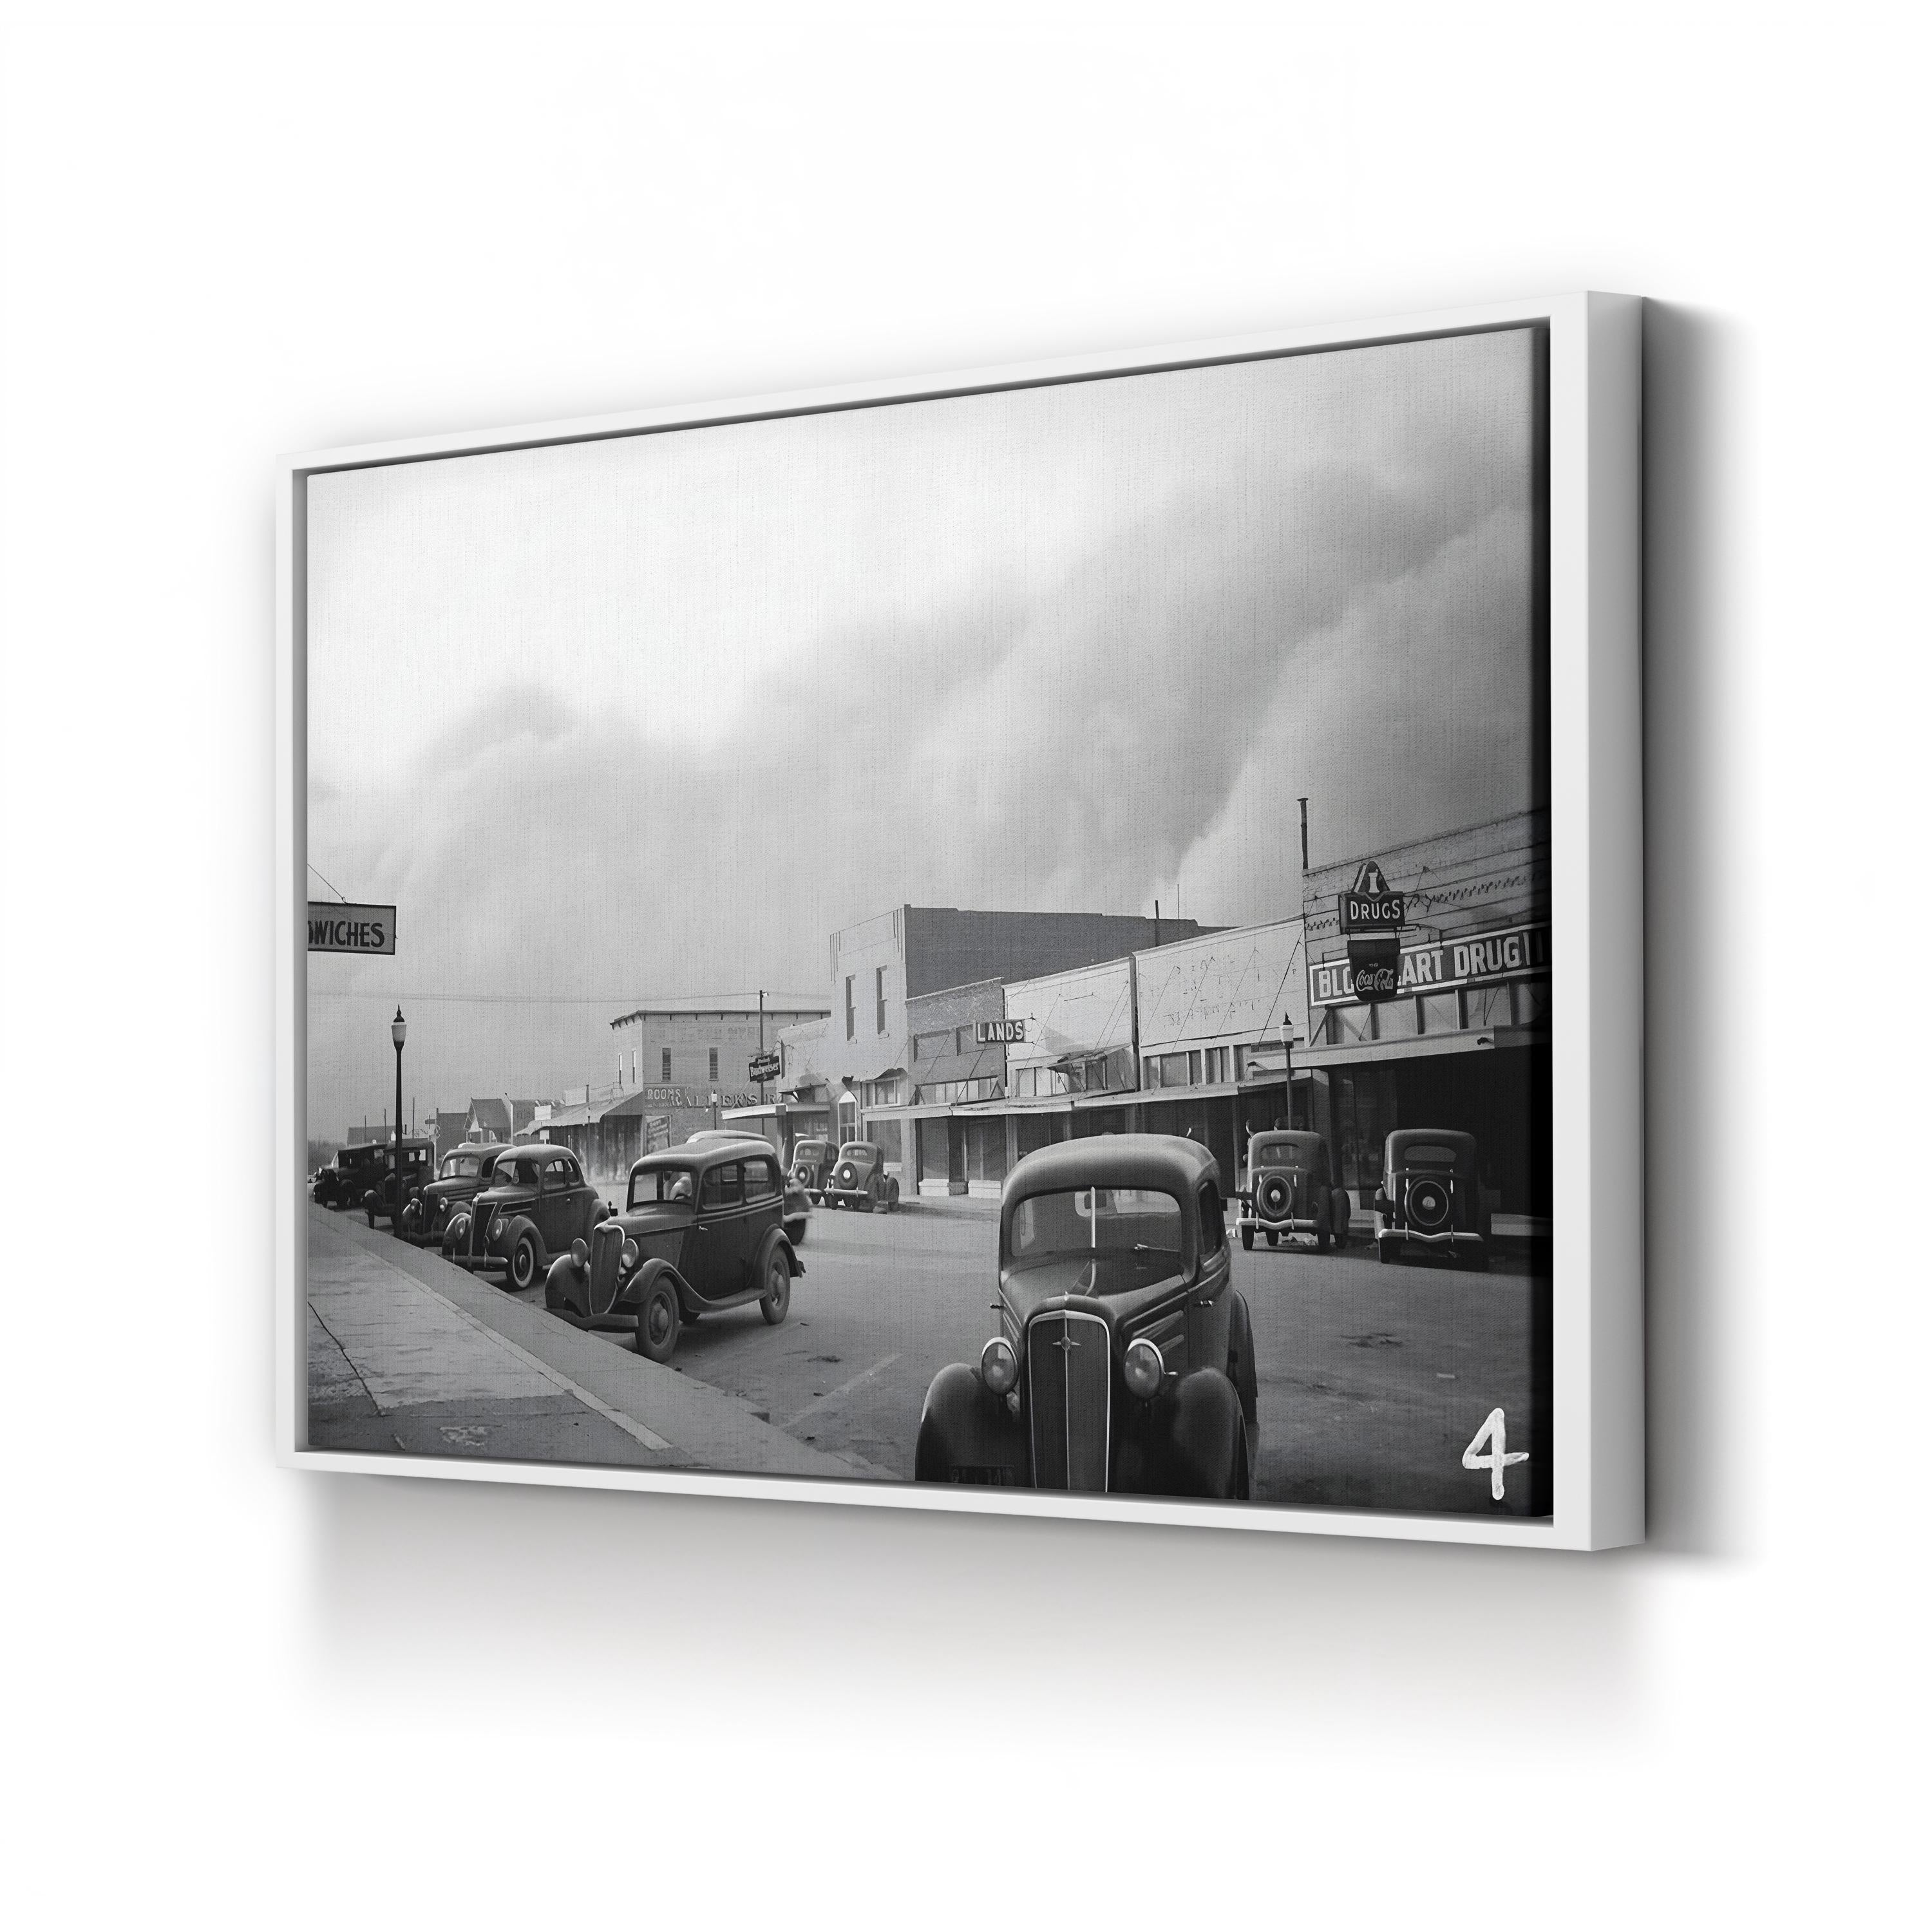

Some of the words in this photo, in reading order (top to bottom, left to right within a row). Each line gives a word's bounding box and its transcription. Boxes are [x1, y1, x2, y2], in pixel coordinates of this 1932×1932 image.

[1350, 900, 1401, 920] DRUGS
[976, 1021, 1025, 1041] LANDS
[1461, 1406, 1529, 1501] 4
